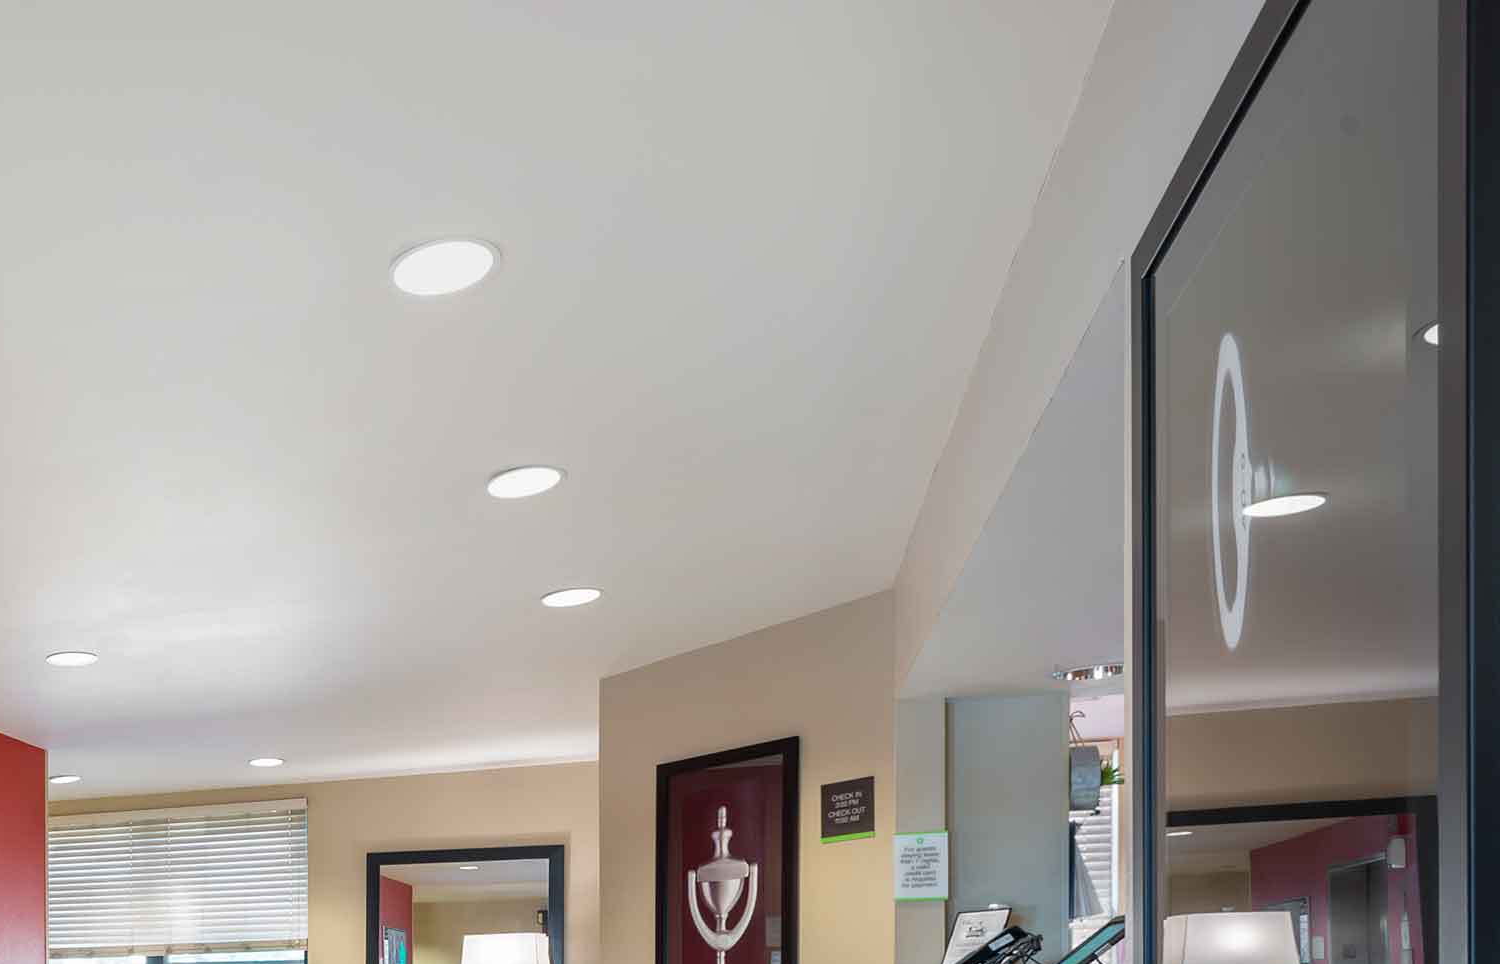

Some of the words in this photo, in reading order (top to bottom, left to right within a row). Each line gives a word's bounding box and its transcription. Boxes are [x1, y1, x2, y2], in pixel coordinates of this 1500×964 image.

[831, 792, 853, 802] CHECK
[828, 809, 851, 818] CHECK
[852, 806, 866, 815] OUT
